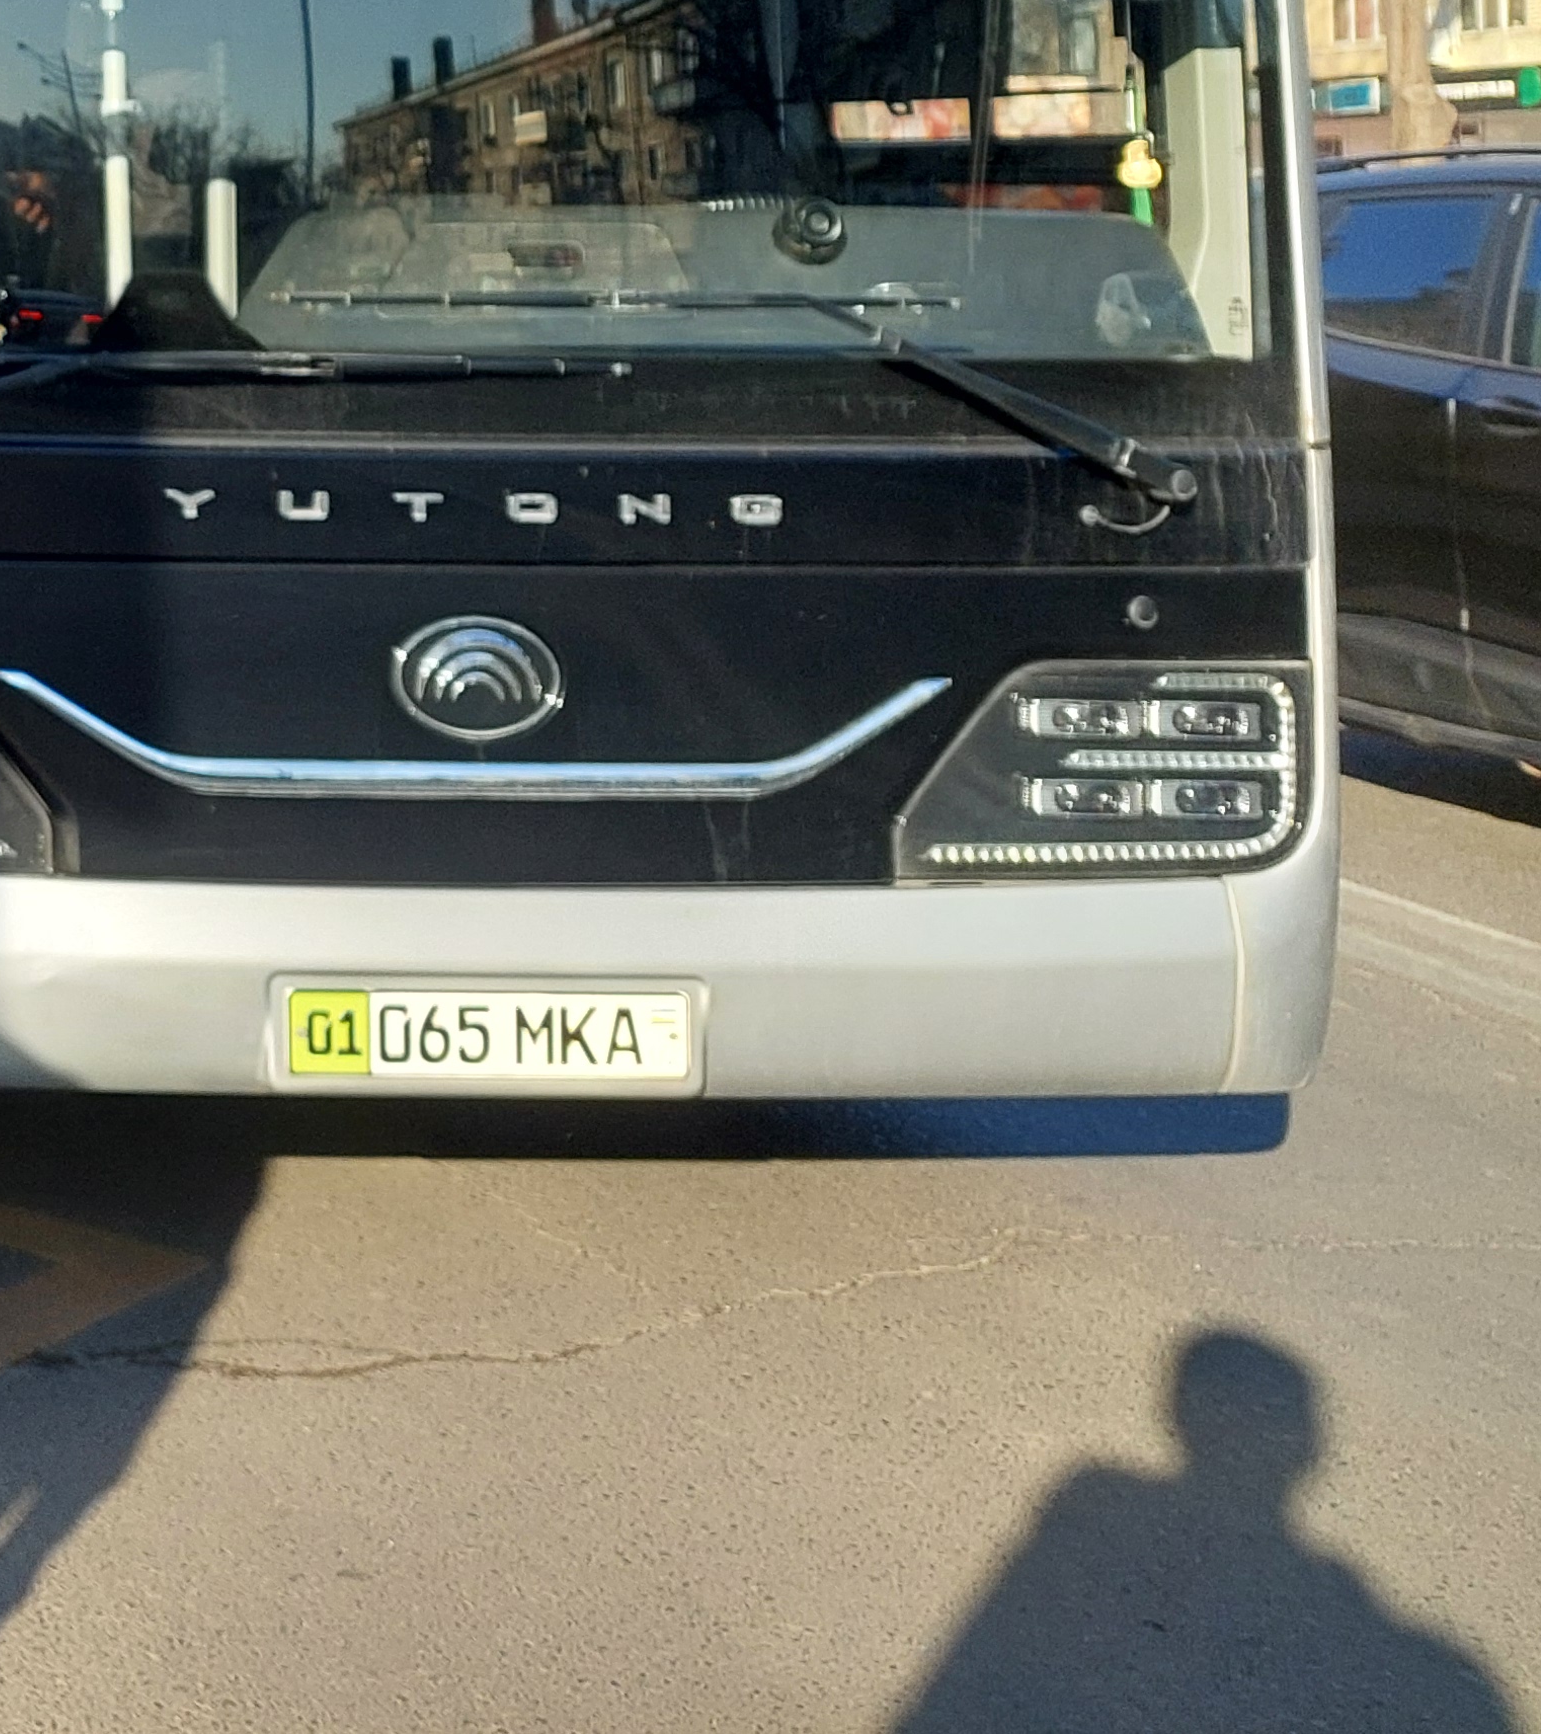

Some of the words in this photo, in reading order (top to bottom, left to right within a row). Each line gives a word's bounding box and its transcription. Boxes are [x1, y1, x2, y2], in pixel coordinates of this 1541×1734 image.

[164, 485, 784, 528] YUTONG
[305, 1008, 363, 1057] 01
[378, 1003, 491, 1064] 065
[514, 1005, 643, 1066] MKA
